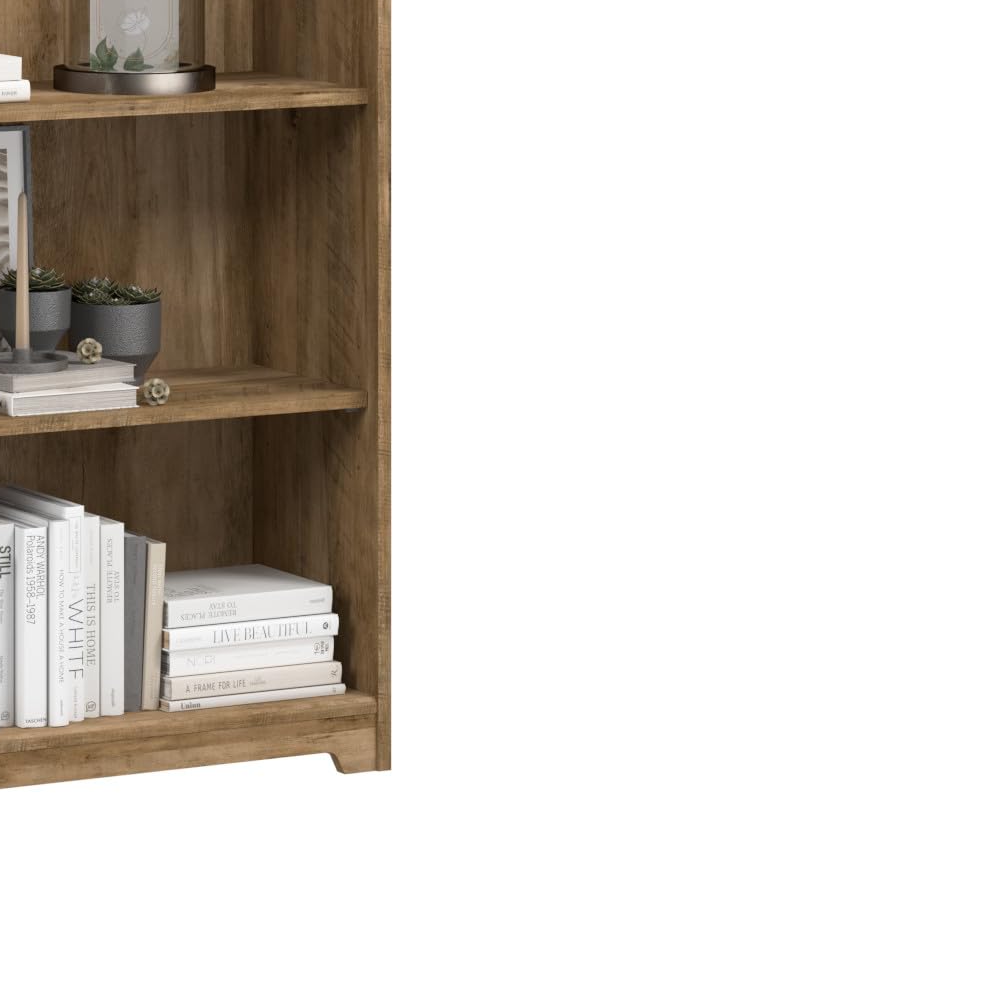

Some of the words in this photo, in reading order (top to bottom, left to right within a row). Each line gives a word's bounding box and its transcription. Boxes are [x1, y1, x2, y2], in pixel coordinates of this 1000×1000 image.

[26, 535, 35, 574] Polaroids
[36, 535, 46, 558] ANDY
[0, 545, 11, 579] STILL
[36, 561, 46, 599] WARHOL
[59, 589, 65, 599] TO
[86, 584, 96, 613] THIS
[226, 601, 237, 609] TO
[180, 611, 206, 621] PLACES
[208, 602, 225, 610] STAY
[208, 610, 237, 619] REMOTE
[86, 616, 96, 629] IS
[213, 628, 241, 644] LIVE
[244, 621, 312, 641] BEAUTIFUL
[68, 598, 84, 679] WHITE
[86, 631, 96, 667] HOME
[186, 685, 190, 693] A
[194, 682, 216, 692] FRAME
[218, 680, 231, 689] FOR
[233, 679, 246, 688] LIFE
